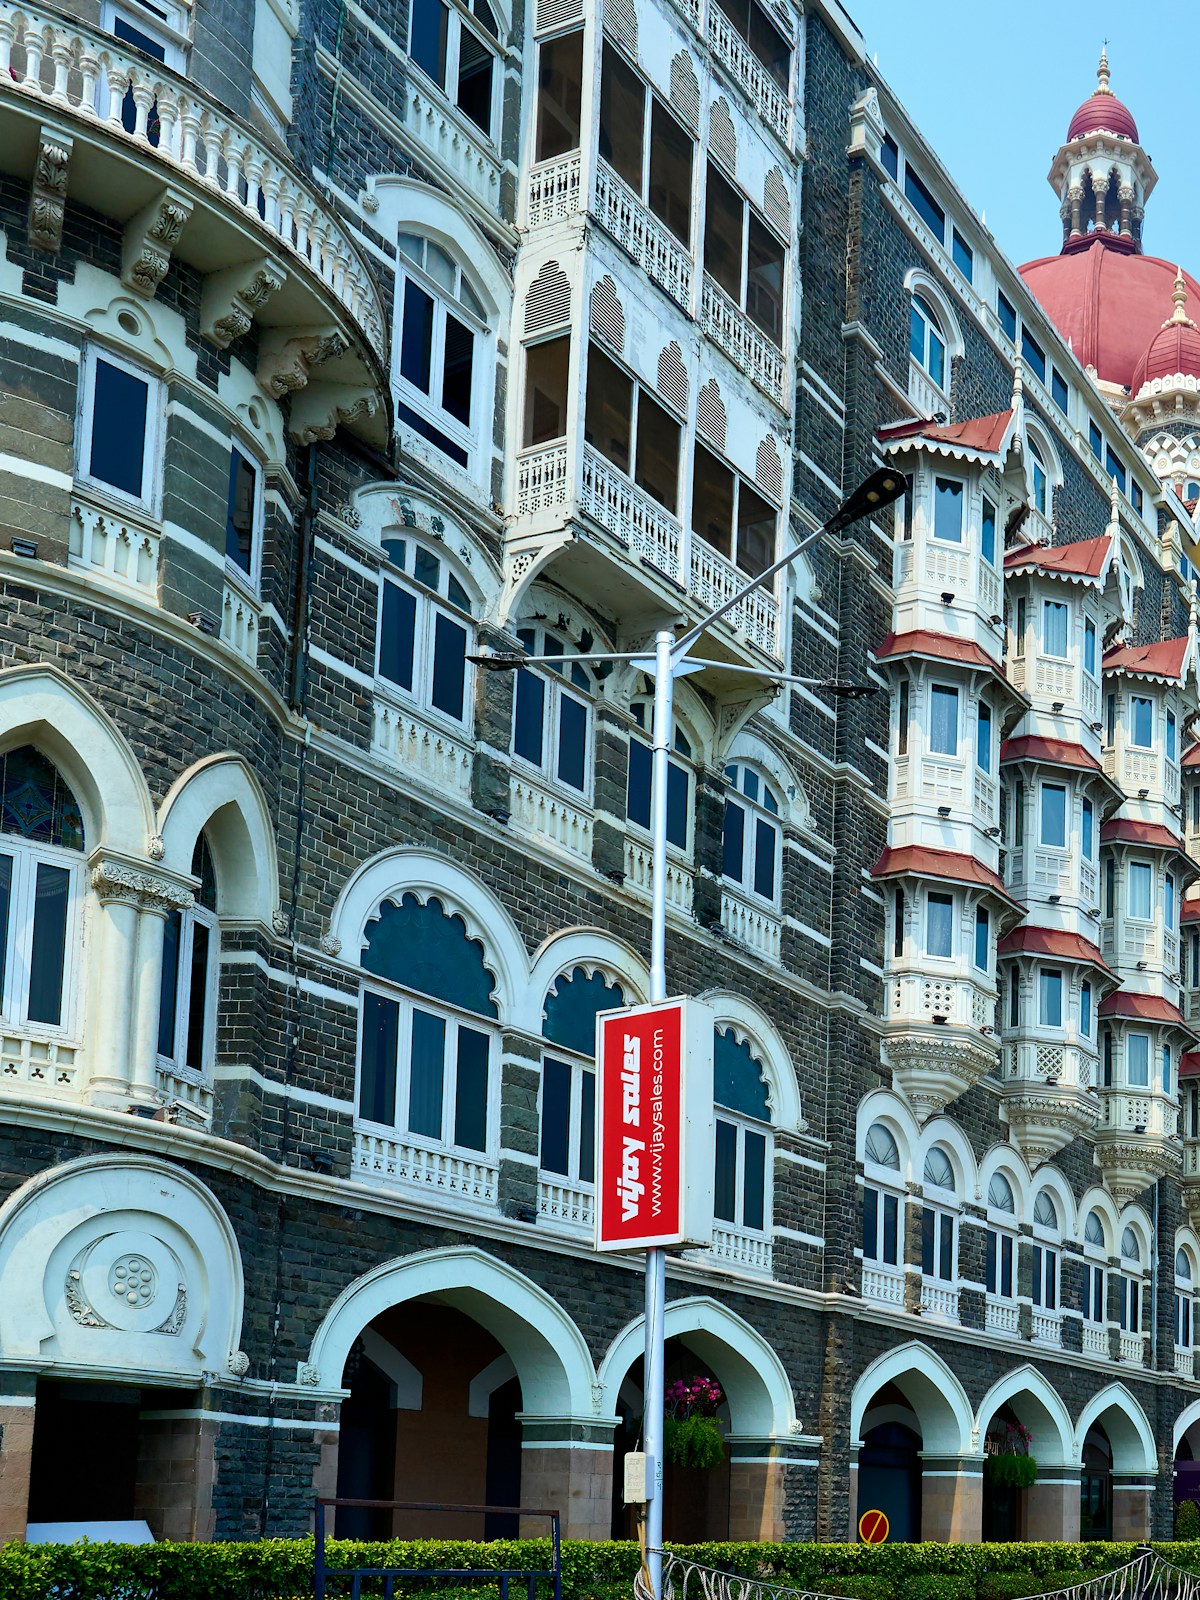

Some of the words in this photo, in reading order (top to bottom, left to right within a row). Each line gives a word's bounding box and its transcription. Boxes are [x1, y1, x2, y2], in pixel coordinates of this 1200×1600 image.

[620, 1033, 641, 1127] sales
[649, 1028, 665, 1218] www.vijaysales.com
[617, 1136, 645, 1223] vijay
